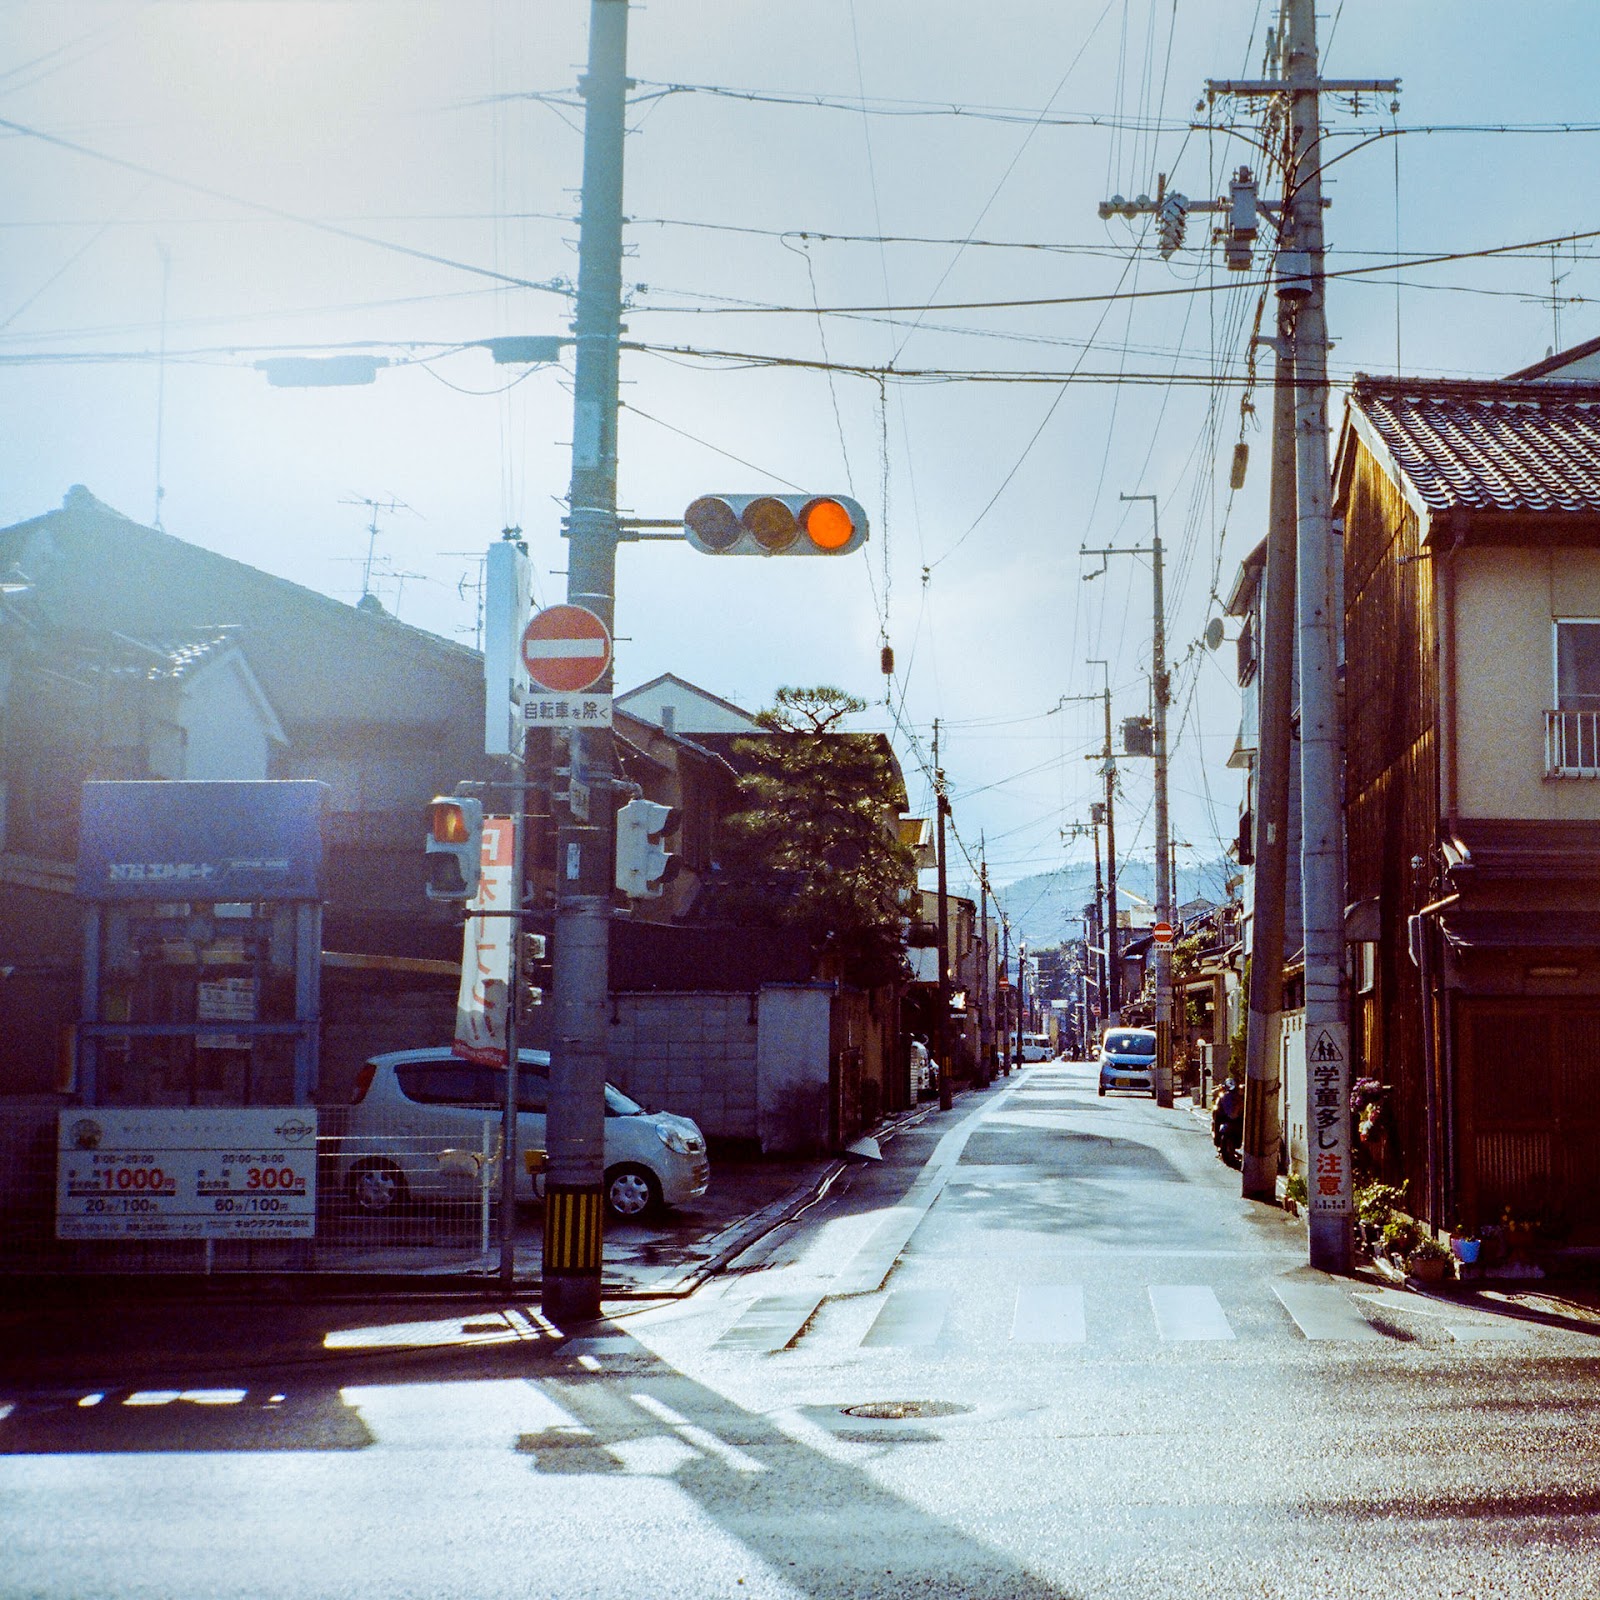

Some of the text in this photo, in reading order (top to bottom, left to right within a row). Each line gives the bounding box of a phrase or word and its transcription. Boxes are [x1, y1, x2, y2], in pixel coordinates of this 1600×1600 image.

[524, 701, 608, 720] 自転車を除く
[1313, 1066, 1342, 1196] 学童多し注意
